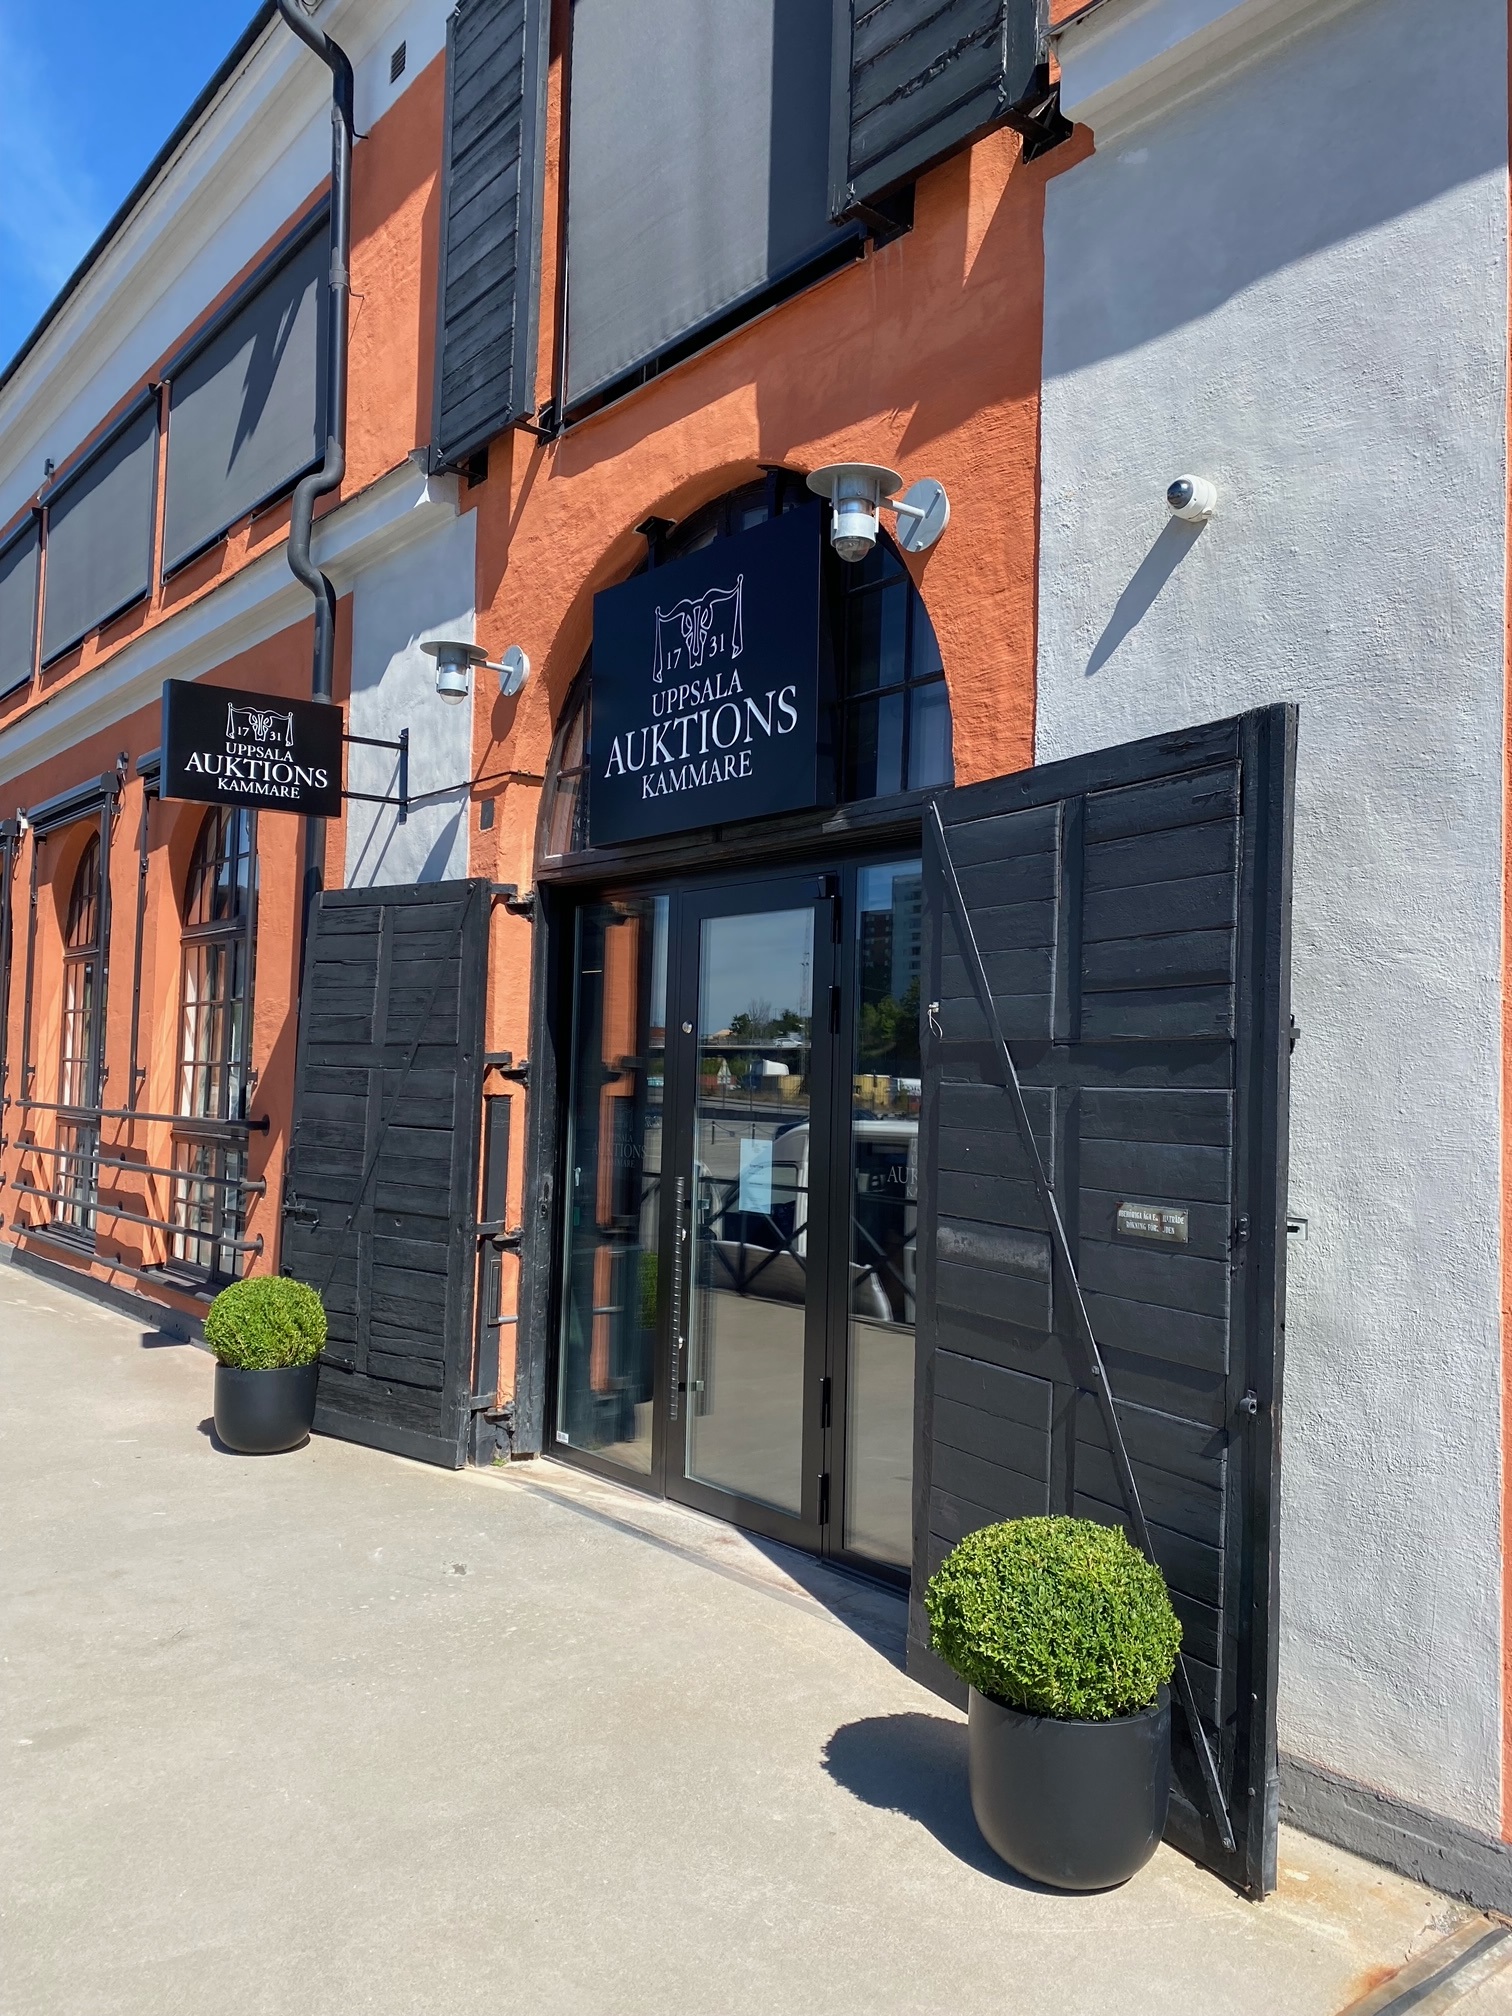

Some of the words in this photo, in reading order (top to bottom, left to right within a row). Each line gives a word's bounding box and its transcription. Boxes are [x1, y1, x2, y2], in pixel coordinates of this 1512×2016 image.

[667, 648, 682, 670] 17
[709, 633, 725, 658] 31
[652, 668, 744, 718] UPPSALA
[237, 726, 250, 737] 17
[269, 731, 281, 742] 31
[604, 685, 798, 779] AUKTIONS
[184, 752, 328, 789] AUKTIONS
[225, 742, 294, 763] UPPSALA
[217, 777, 301, 800] KAMMARE
[641, 750, 753, 800] KAMMARE
